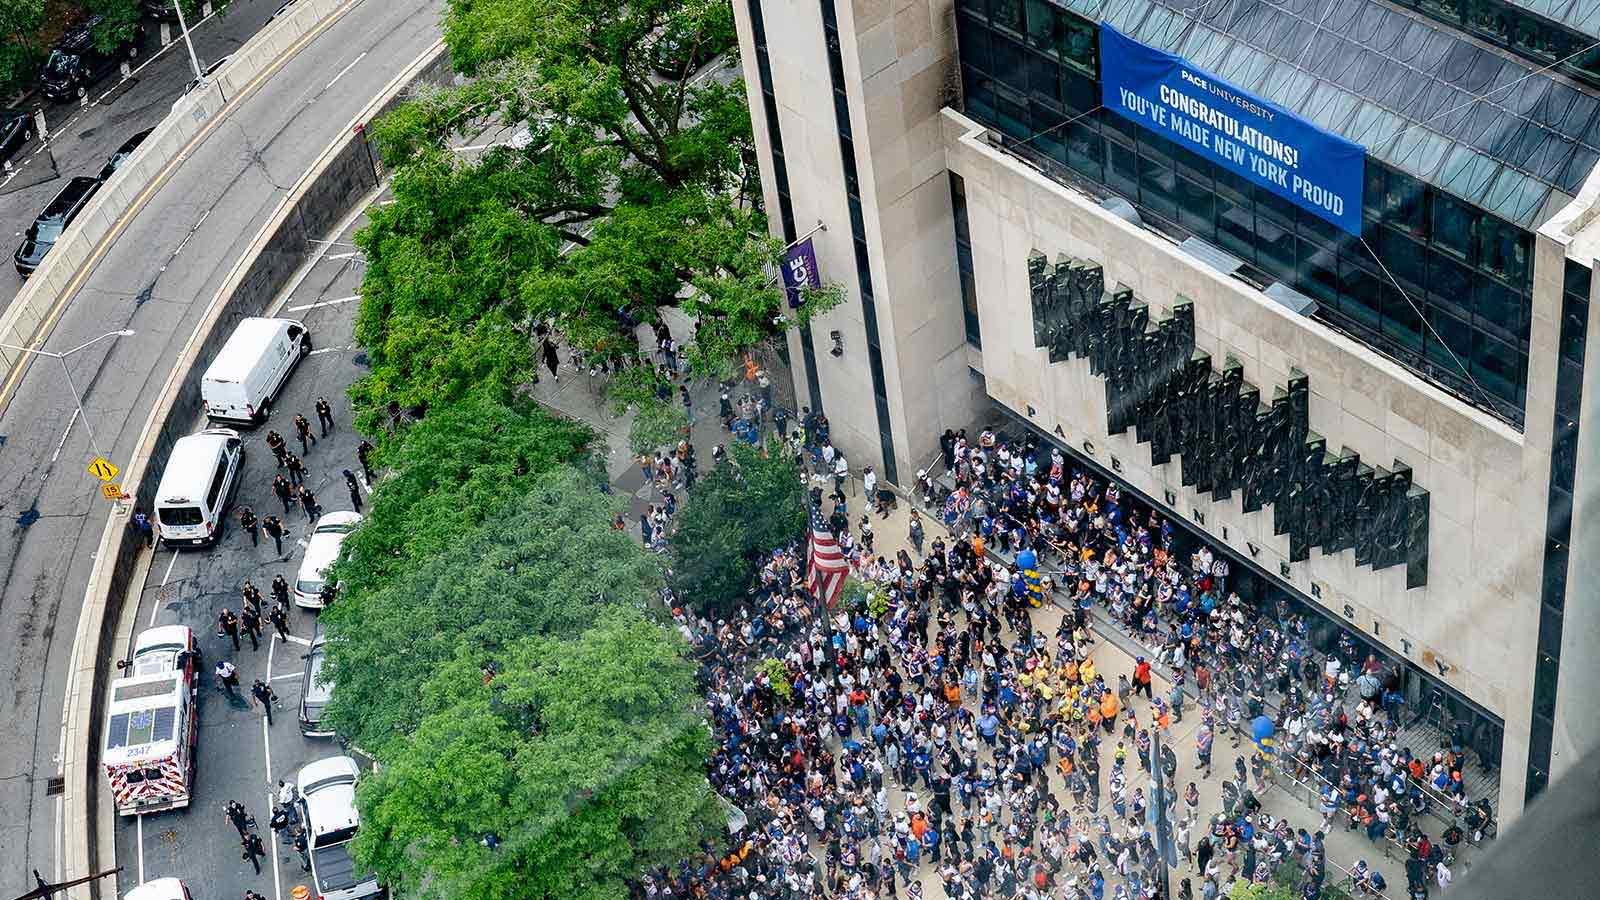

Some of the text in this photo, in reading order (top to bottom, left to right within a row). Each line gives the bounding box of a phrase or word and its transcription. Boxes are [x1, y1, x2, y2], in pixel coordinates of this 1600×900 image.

[1160, 84, 1298, 169] CONGRATULATIONS!
[1181, 70, 1274, 121] PACE UNIVERSITY
[1119, 86, 1344, 217] YOU'VE MADE NEW YORK PROUD
[106, 486, 118, 494] 15
[1026, 404, 1450, 677] PACE UNIVERSITY
[128, 745, 151, 757] 2347
